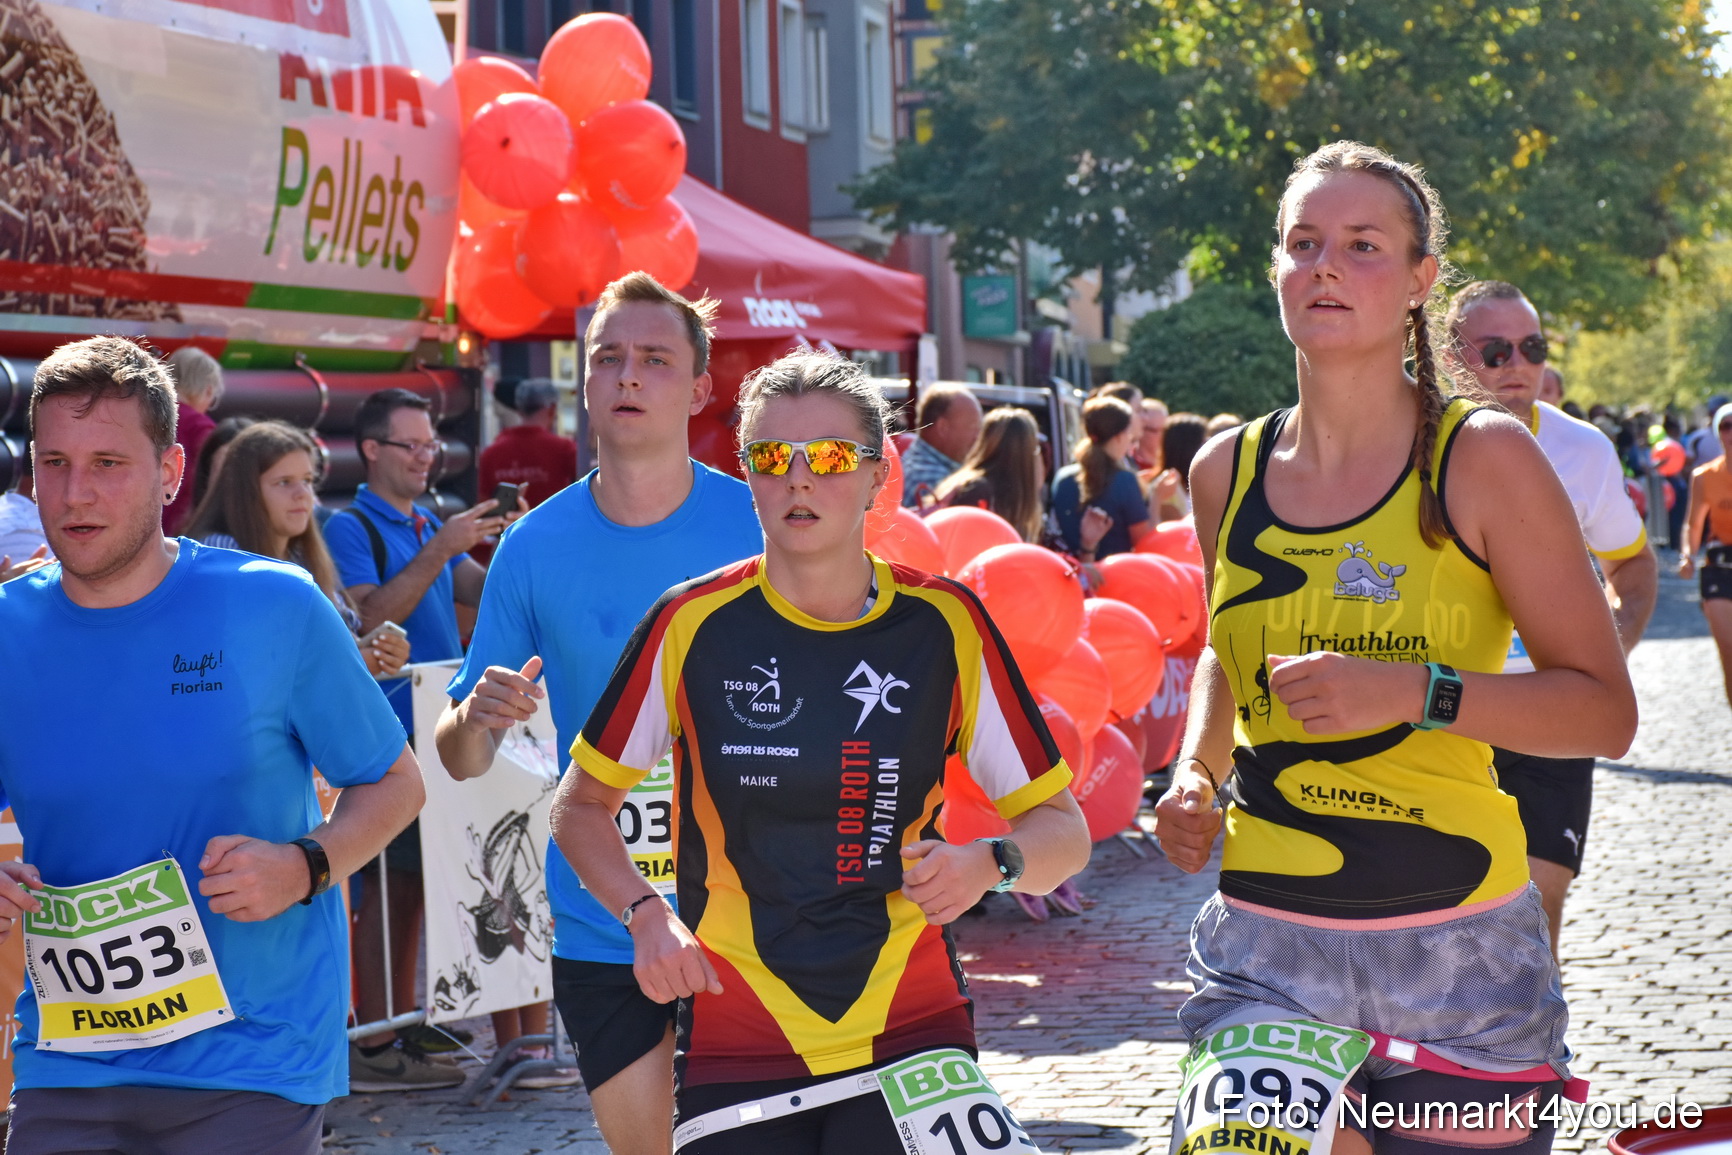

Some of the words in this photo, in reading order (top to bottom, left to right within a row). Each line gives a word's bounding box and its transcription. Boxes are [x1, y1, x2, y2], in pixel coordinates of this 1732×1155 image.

[264, 126, 424, 272] Pellets
[1333, 582, 1401, 605] beluga
[1301, 631, 1429, 653] Triathlon
[173, 650, 223, 677] läuft!
[171, 680, 223, 695] Florian
[723, 680, 744, 691] TSG
[745, 682, 759, 692] 08
[746, 696, 804, 732] Sportgemeinschaft
[752, 702, 780, 713] ROTH
[740, 775, 778, 787] MAIKE
[839, 740, 871, 800] ROTH
[867, 757, 900, 869] TRIATHLON
[1300, 783, 1424, 820] KLINGEE
[836, 806, 866, 835] 08
[836, 842, 865, 886] TSG
[32, 870, 174, 931] BOCK
[181, 921, 192, 933] D
[40, 925, 186, 995] 1053
[72, 992, 189, 1031] FLORIAN
[893, 1056, 995, 1107] BO
